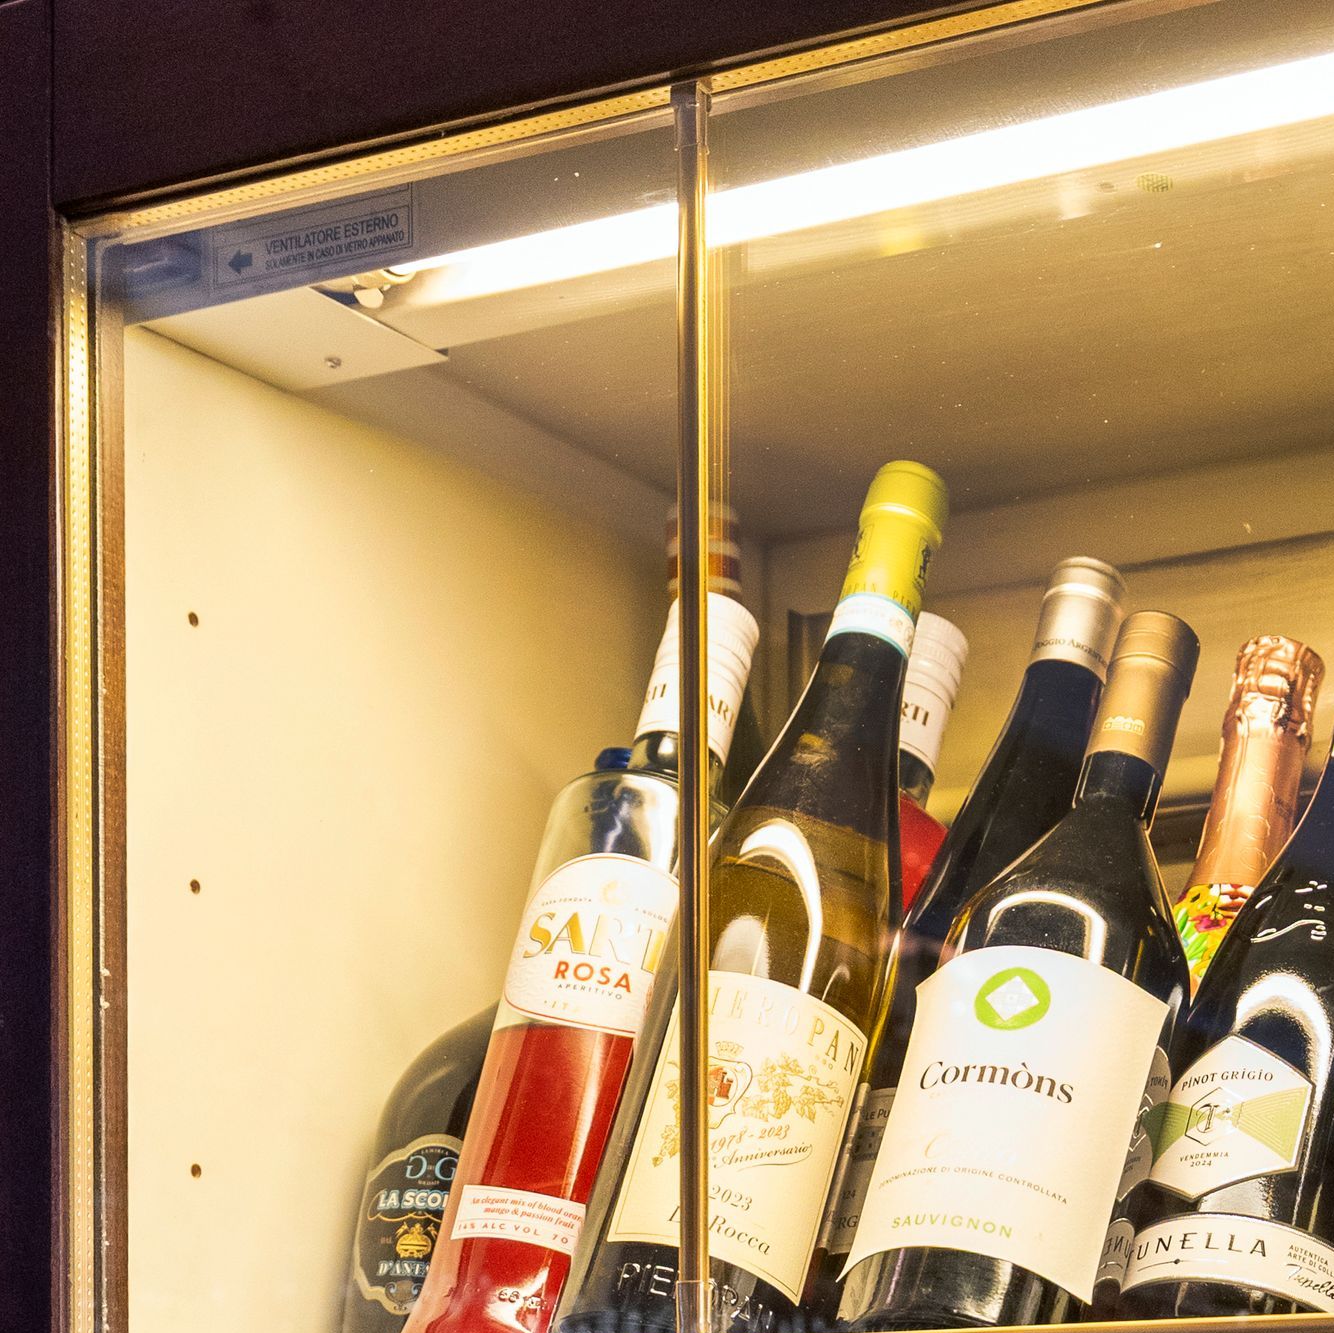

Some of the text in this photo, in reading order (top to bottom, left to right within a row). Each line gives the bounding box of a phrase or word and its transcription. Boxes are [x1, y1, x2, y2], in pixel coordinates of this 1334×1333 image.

[266, 213, 399, 254] VENTILATORE ESTERNO
[315, 246, 334, 261] CASO
[341, 238, 368, 256] VETRO
[368, 230, 405, 249] APPANATO
[554, 961, 631, 993] ROSA
[558, 983, 623, 1000] APERITIVO
[709, 986, 860, 1077] IEROPAN
[920, 1060, 1074, 1104] Cormòns
[1220, 1068, 1274, 1082] GRIGIO
[759, 1124, 791, 1141] 2023
[713, 1145, 810, 1169] Anniversario
[1179, 1151, 1230, 1163] VENDEMMIA
[1189, 1159, 1213, 1168] 2024
[953, 1166, 995, 1179] ORIGINE
[997, 1173, 1069, 1205] CONTROLLATA
[377, 1189, 398, 1210] LA
[481, 1196, 562, 1216] elegant mix of blood
[709, 1185, 753, 1212] 2023
[484, 1207, 576, 1230] mango & passion fruit
[891, 1213, 1014, 1239] SAUVIGNON
[482, 1222, 569, 1245] ALC VOL 70
[709, 1214, 771, 1256] Rocca
[1287, 1251, 1309, 1264] ARTE
[1309, 1257, 1318, 1267] DI
[1289, 1244, 1330, 1266] AUTENTICA
